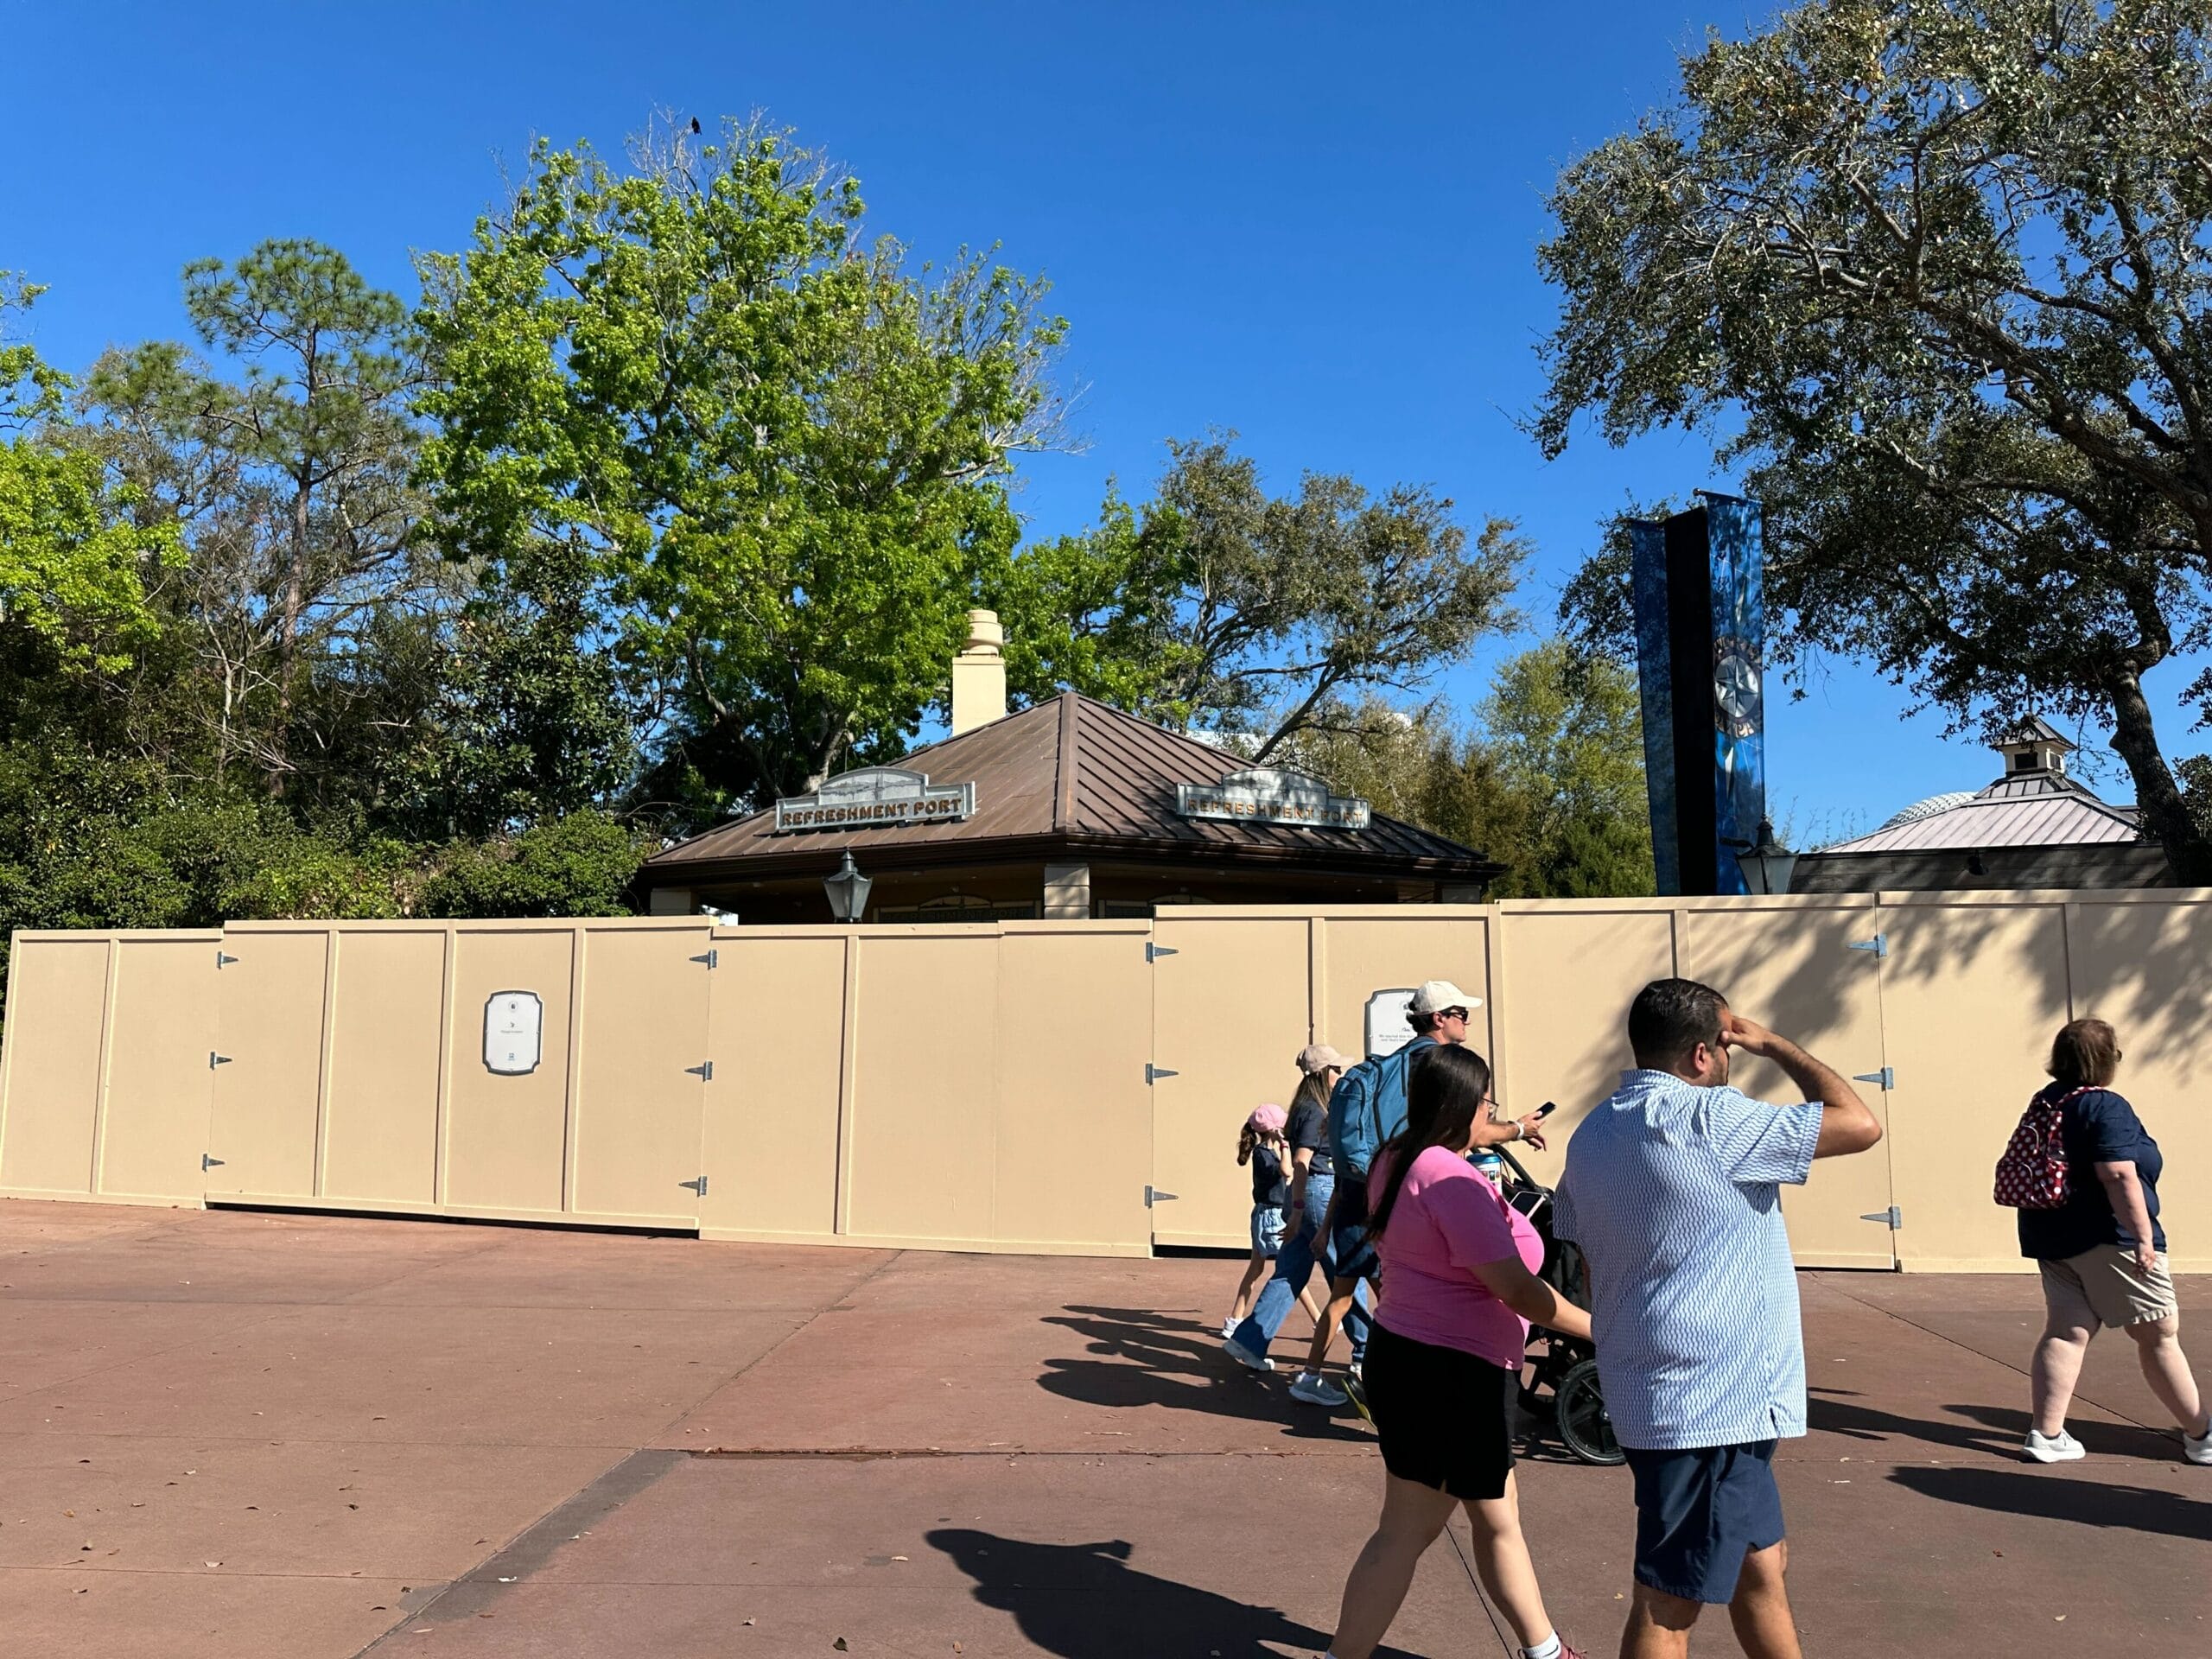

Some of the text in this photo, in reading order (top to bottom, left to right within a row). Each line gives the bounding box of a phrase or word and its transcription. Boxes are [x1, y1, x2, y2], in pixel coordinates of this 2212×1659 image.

[782, 798, 962, 826] REFRESHMENT PORT
[1187, 798, 1363, 823] REFRESHMENT PORT
